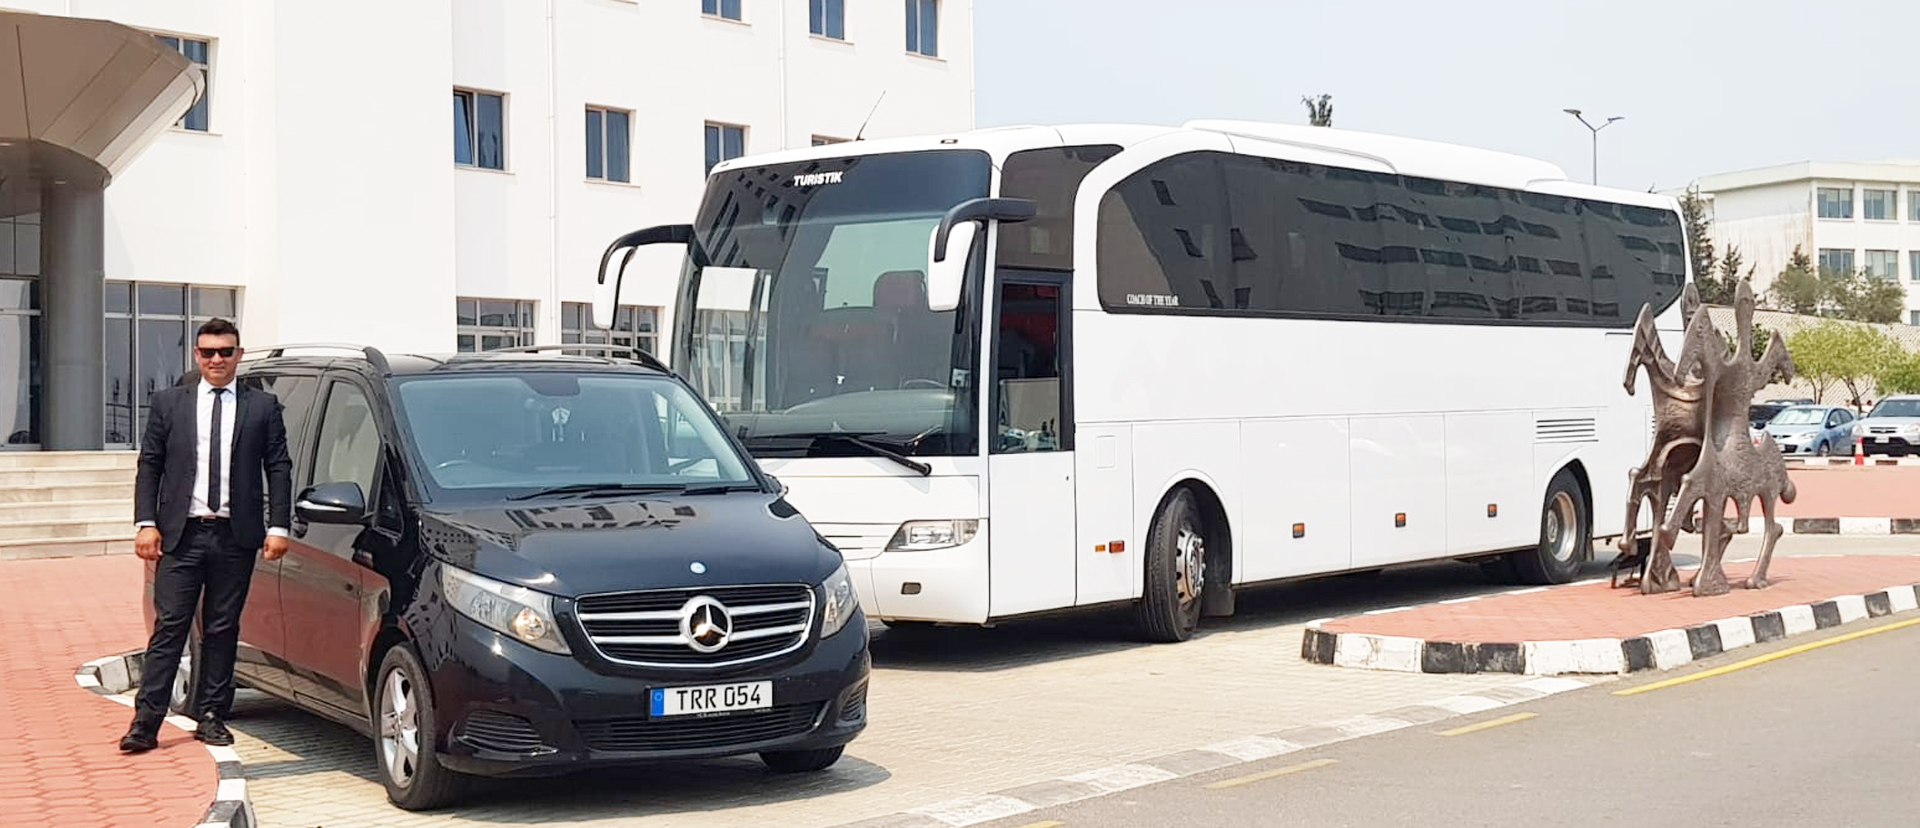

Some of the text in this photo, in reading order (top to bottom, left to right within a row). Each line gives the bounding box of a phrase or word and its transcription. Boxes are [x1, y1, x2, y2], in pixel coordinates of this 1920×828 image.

[793, 171, 843, 187] TURISTIK
[1126, 293, 1146, 305] COACH
[676, 684, 761, 711] TRR 054
